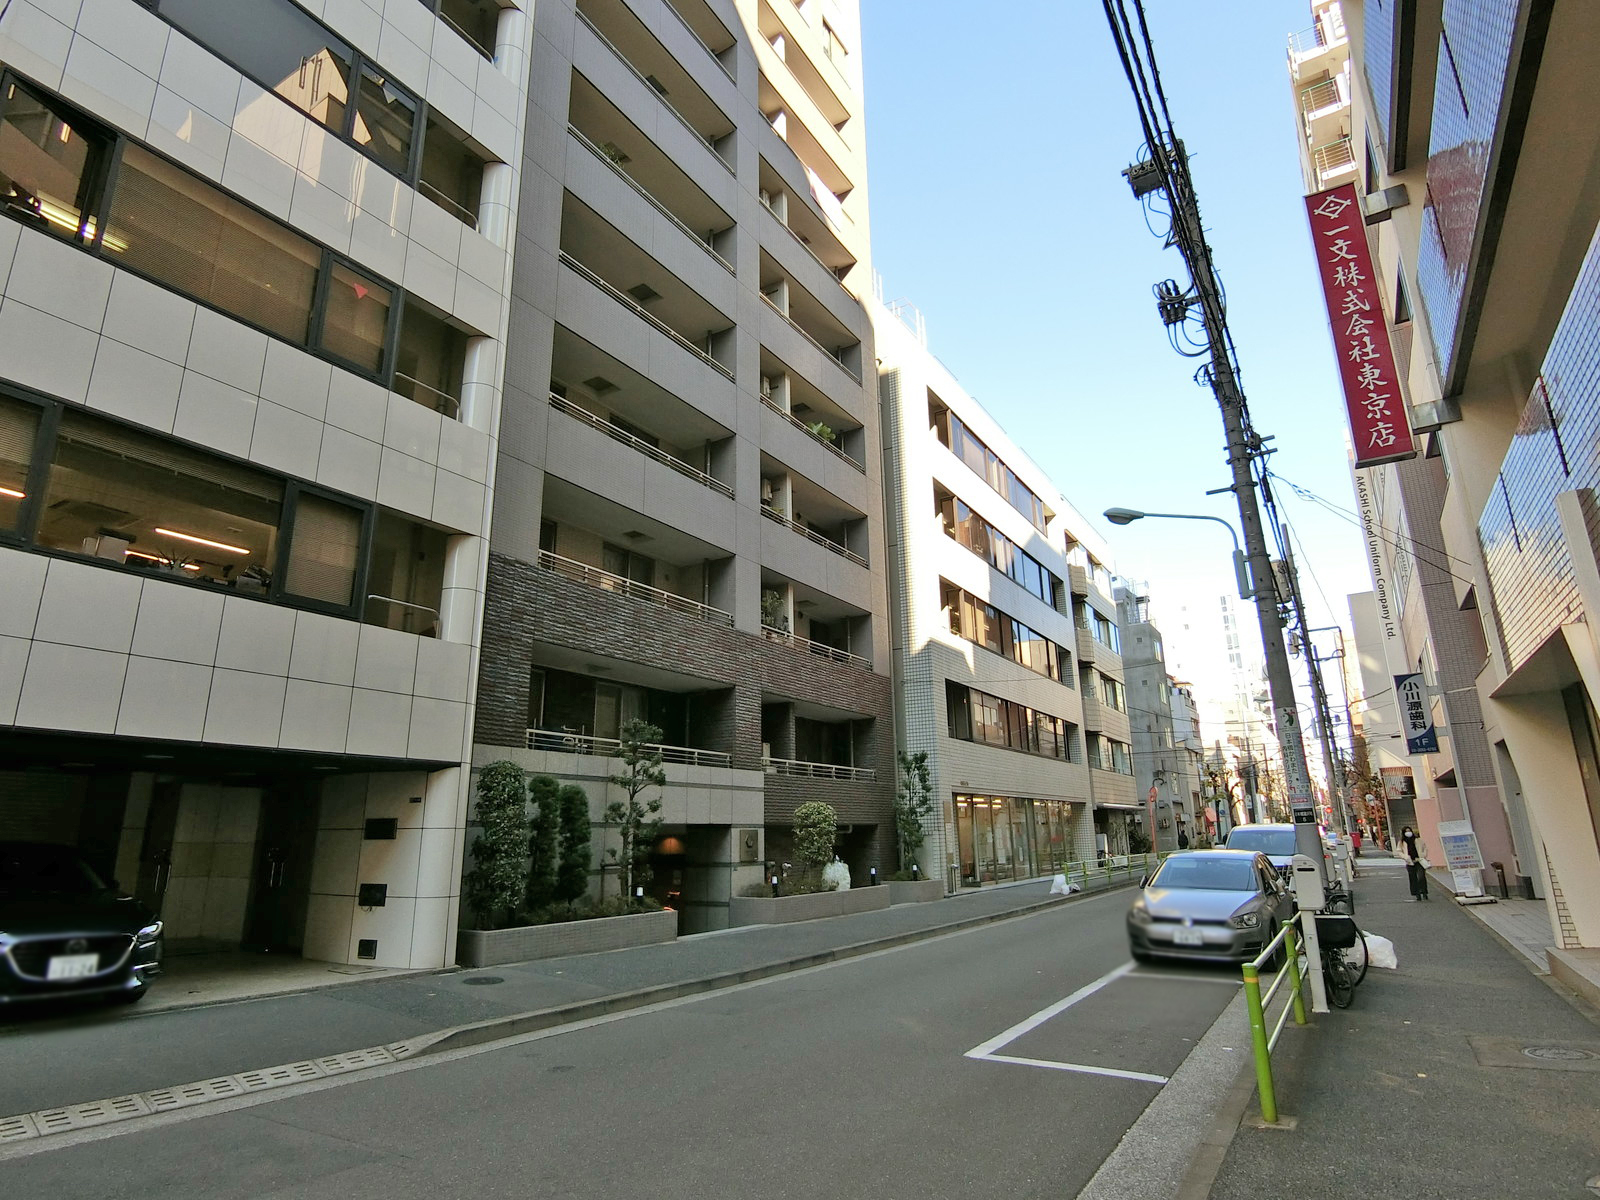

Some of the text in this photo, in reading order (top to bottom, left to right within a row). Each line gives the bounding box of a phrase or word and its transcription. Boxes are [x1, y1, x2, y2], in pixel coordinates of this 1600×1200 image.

[1323, 225, 1397, 449] 一文株式会社東京店
[1356, 475, 1397, 641] AKASHI School Uniform Company Ltd.
[1402, 681, 1428, 731] 小川源歯科
[1415, 738, 1429, 746] 1F
